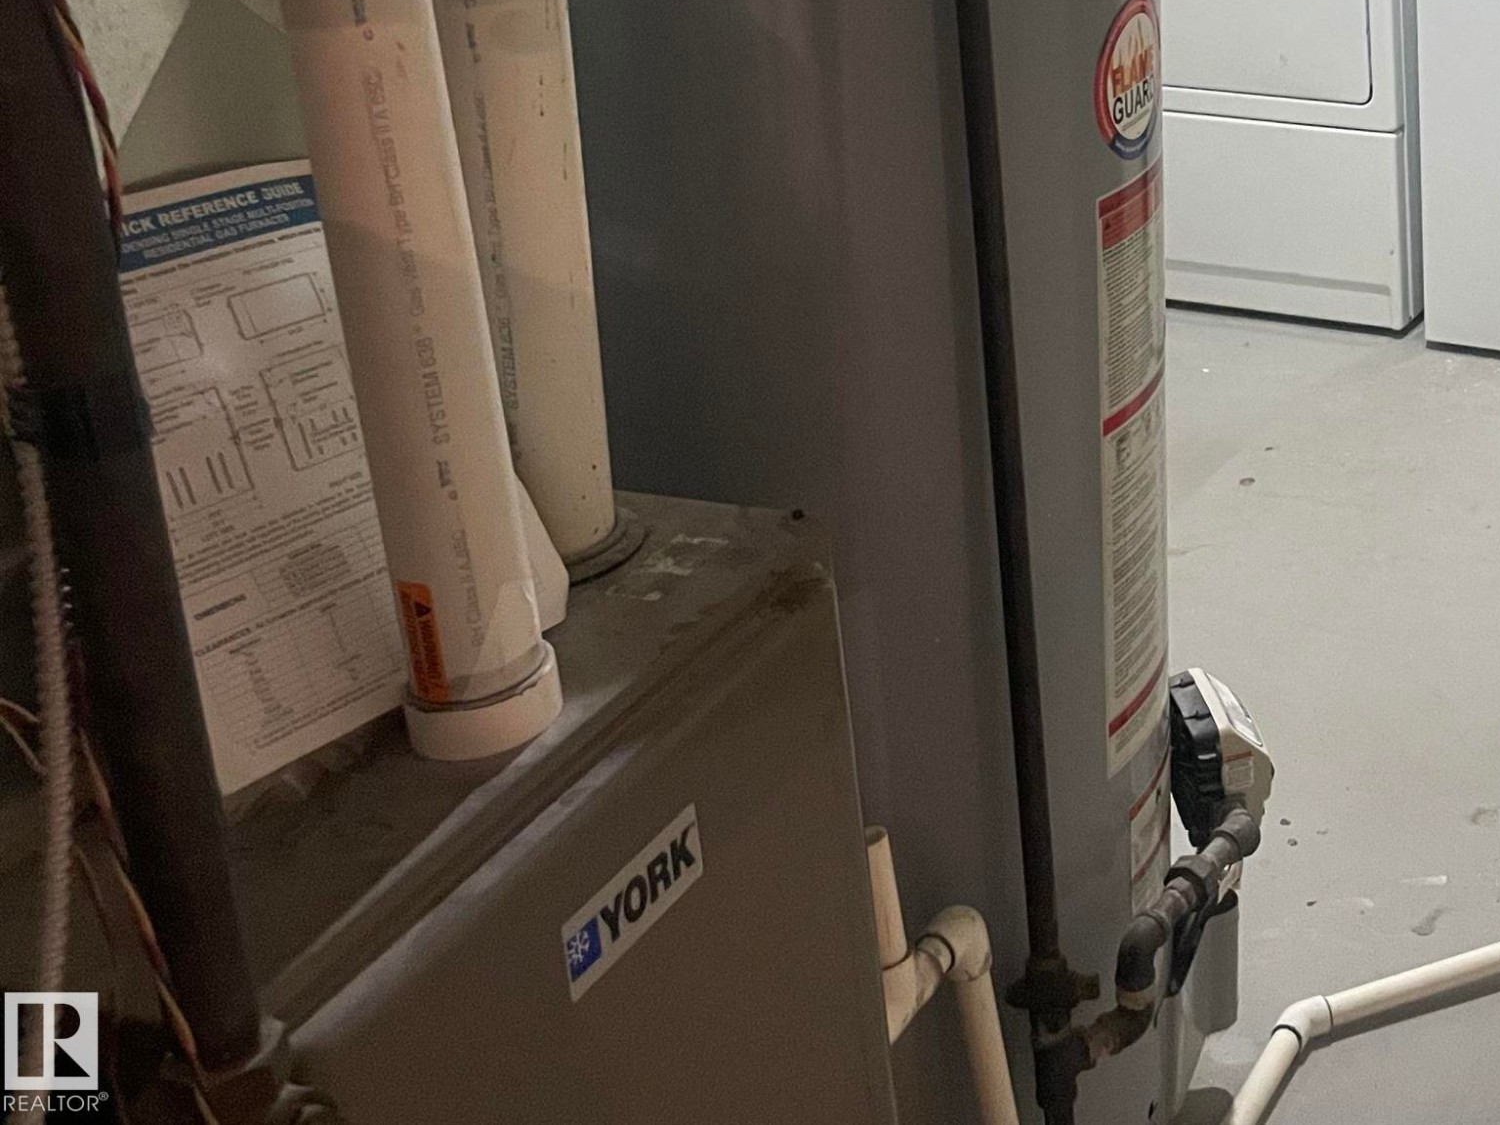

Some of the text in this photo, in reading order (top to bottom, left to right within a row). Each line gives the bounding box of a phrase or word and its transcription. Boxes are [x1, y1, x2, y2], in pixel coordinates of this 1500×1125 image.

[379, 137, 400, 179] Class
[121, 181, 304, 237] ICK REFERENCE GUIDE
[388, 183, 404, 205] BH
[143, 234, 216, 260] RESIDENTIAL
[216, 226, 238, 241] GAS
[393, 209, 413, 245] Type
[407, 287, 425, 316] Gas
[416, 337, 436, 367] 636
[500, 347, 519, 410] SYSTEM
[421, 371, 450, 445] SYSTEM
[600, 821, 696, 943] YORK
